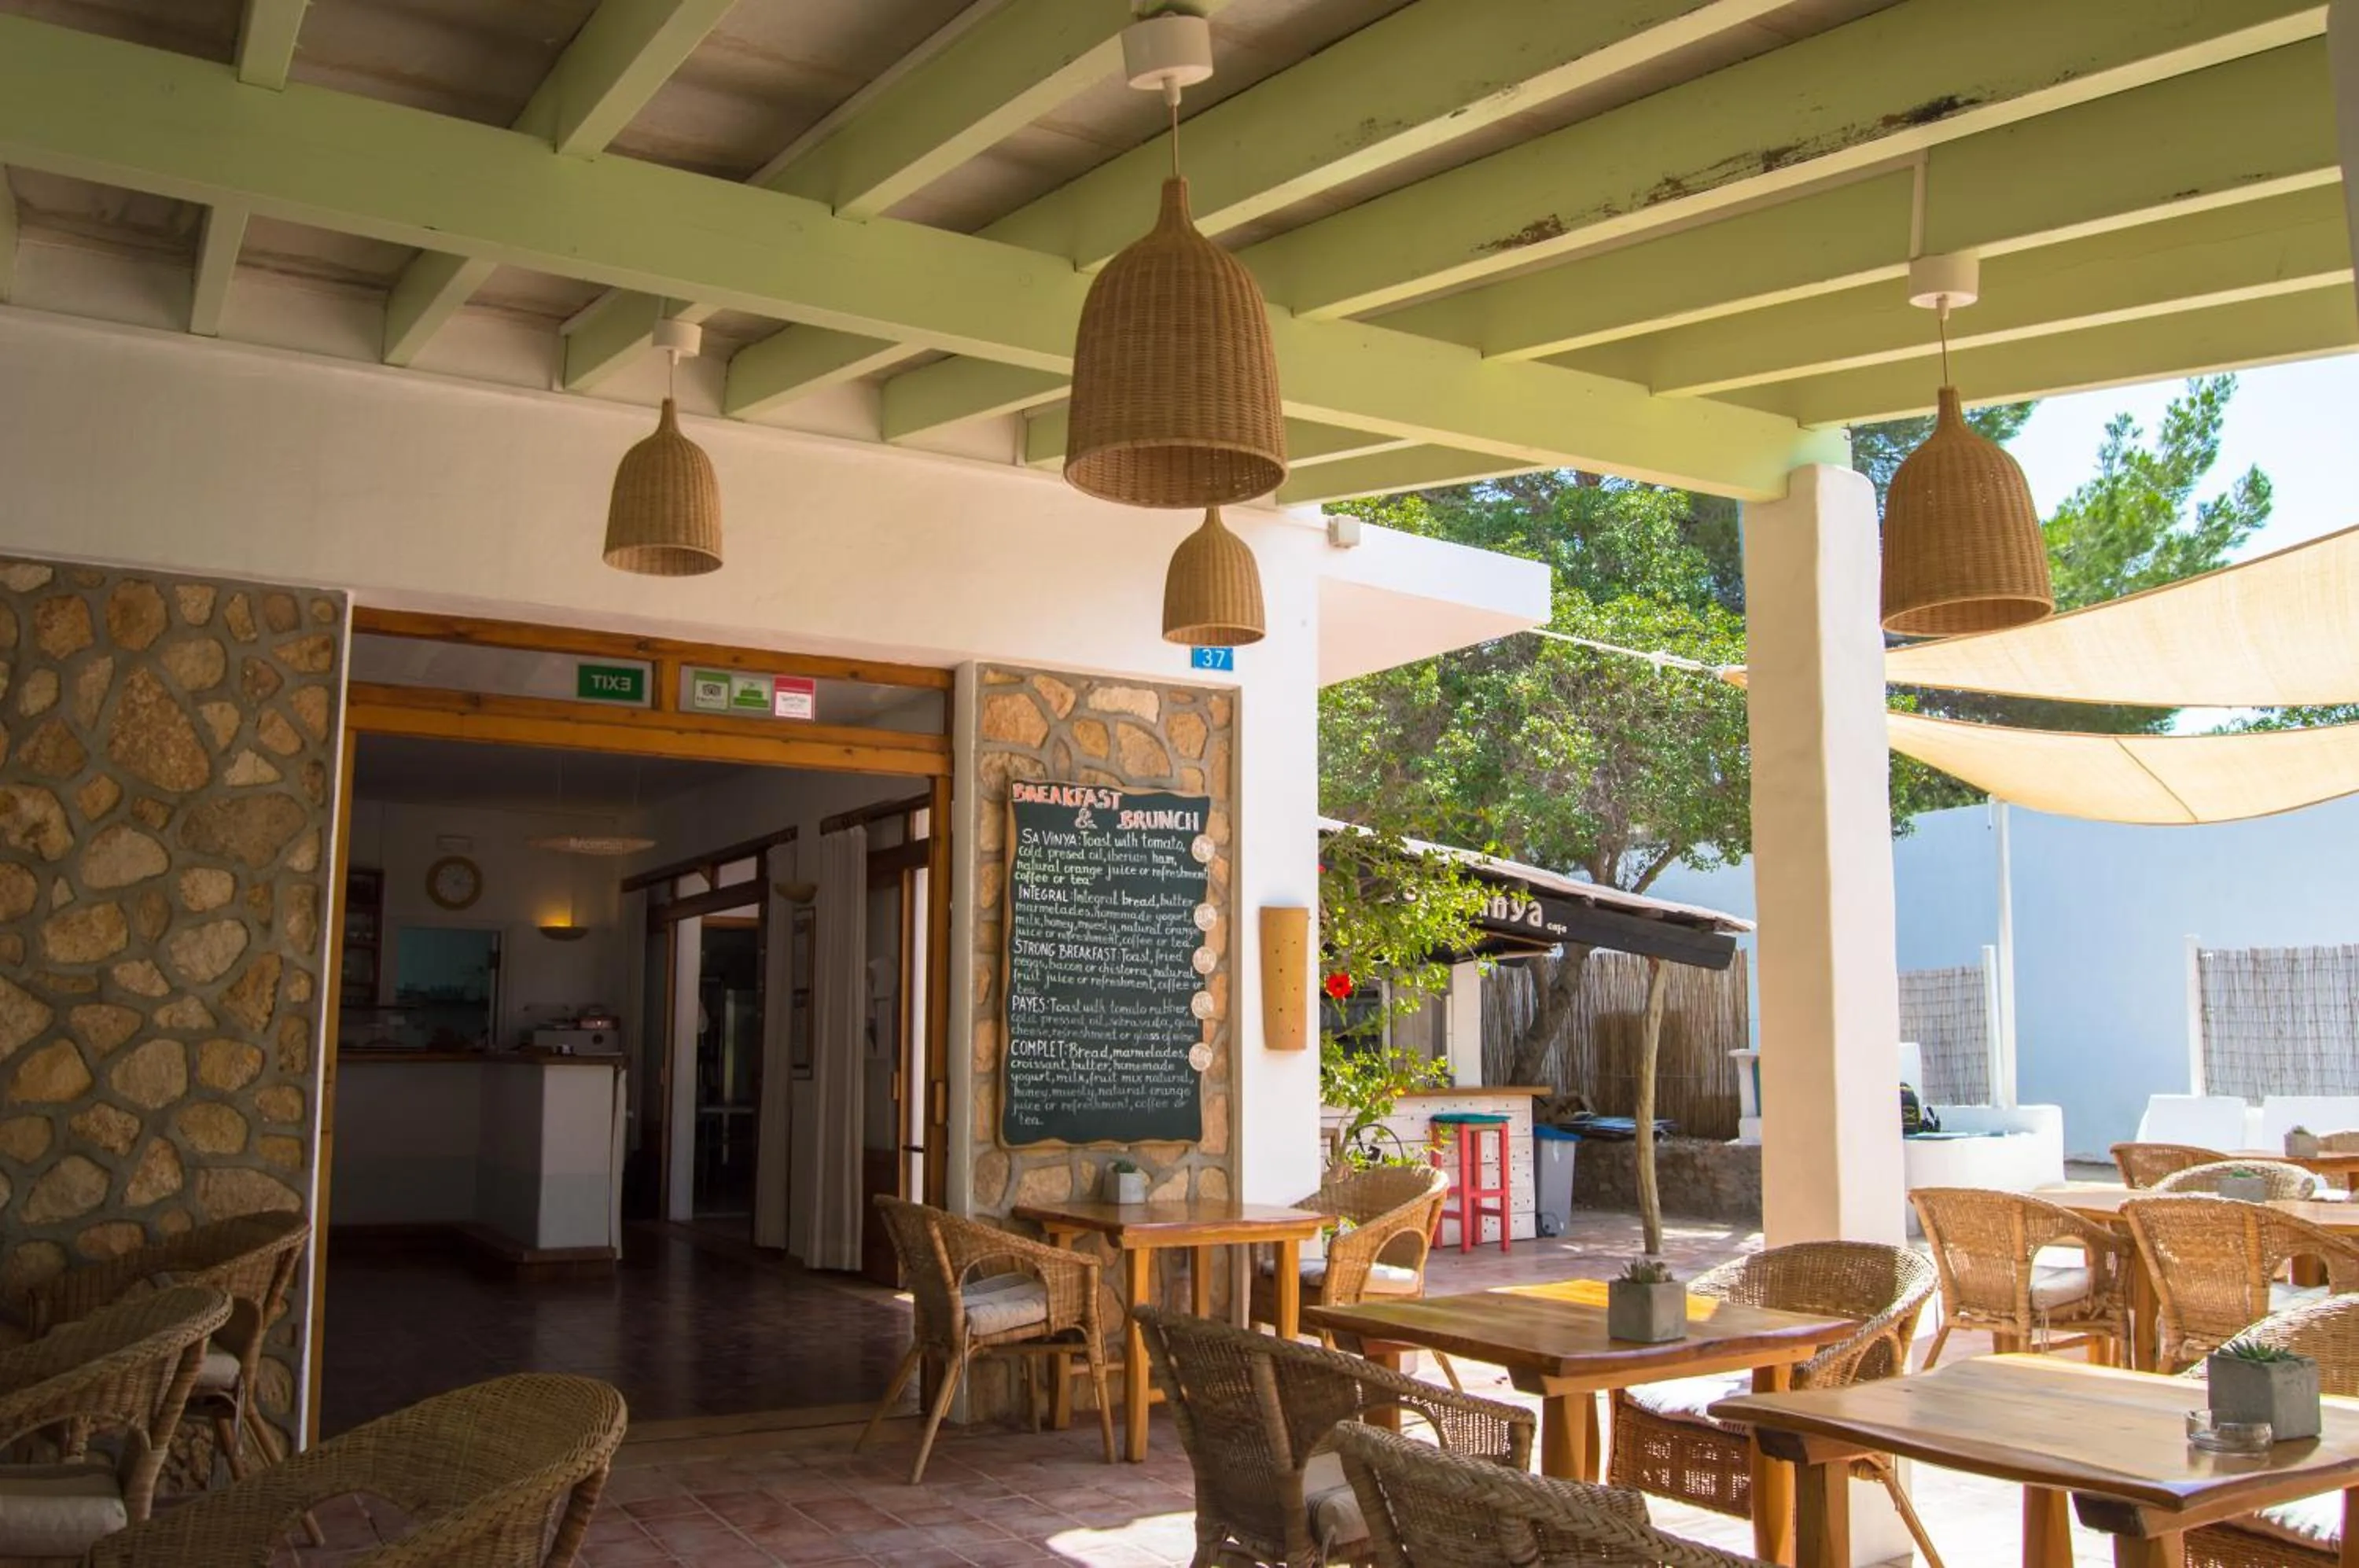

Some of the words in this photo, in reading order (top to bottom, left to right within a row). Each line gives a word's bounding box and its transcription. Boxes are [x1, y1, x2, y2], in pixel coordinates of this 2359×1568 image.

[1202, 649, 1226, 668] 37
[1012, 782, 1122, 811] BREAKFAST
[1074, 808, 1098, 830] &
[1117, 810, 1199, 831] BRUNCH
[1114, 831, 1138, 848] with
[1014, 870, 1049, 885] coffee
[1053, 874, 1066, 884] or
[1017, 858, 1060, 873] natural
[1064, 864, 1103, 881] orange
[1105, 864, 1137, 881] juice
[1139, 867, 1150, 875] or
[1014, 940, 1056, 957] STRONG
[1085, 963, 1098, 974] or
[1076, 976, 1088, 985] or
